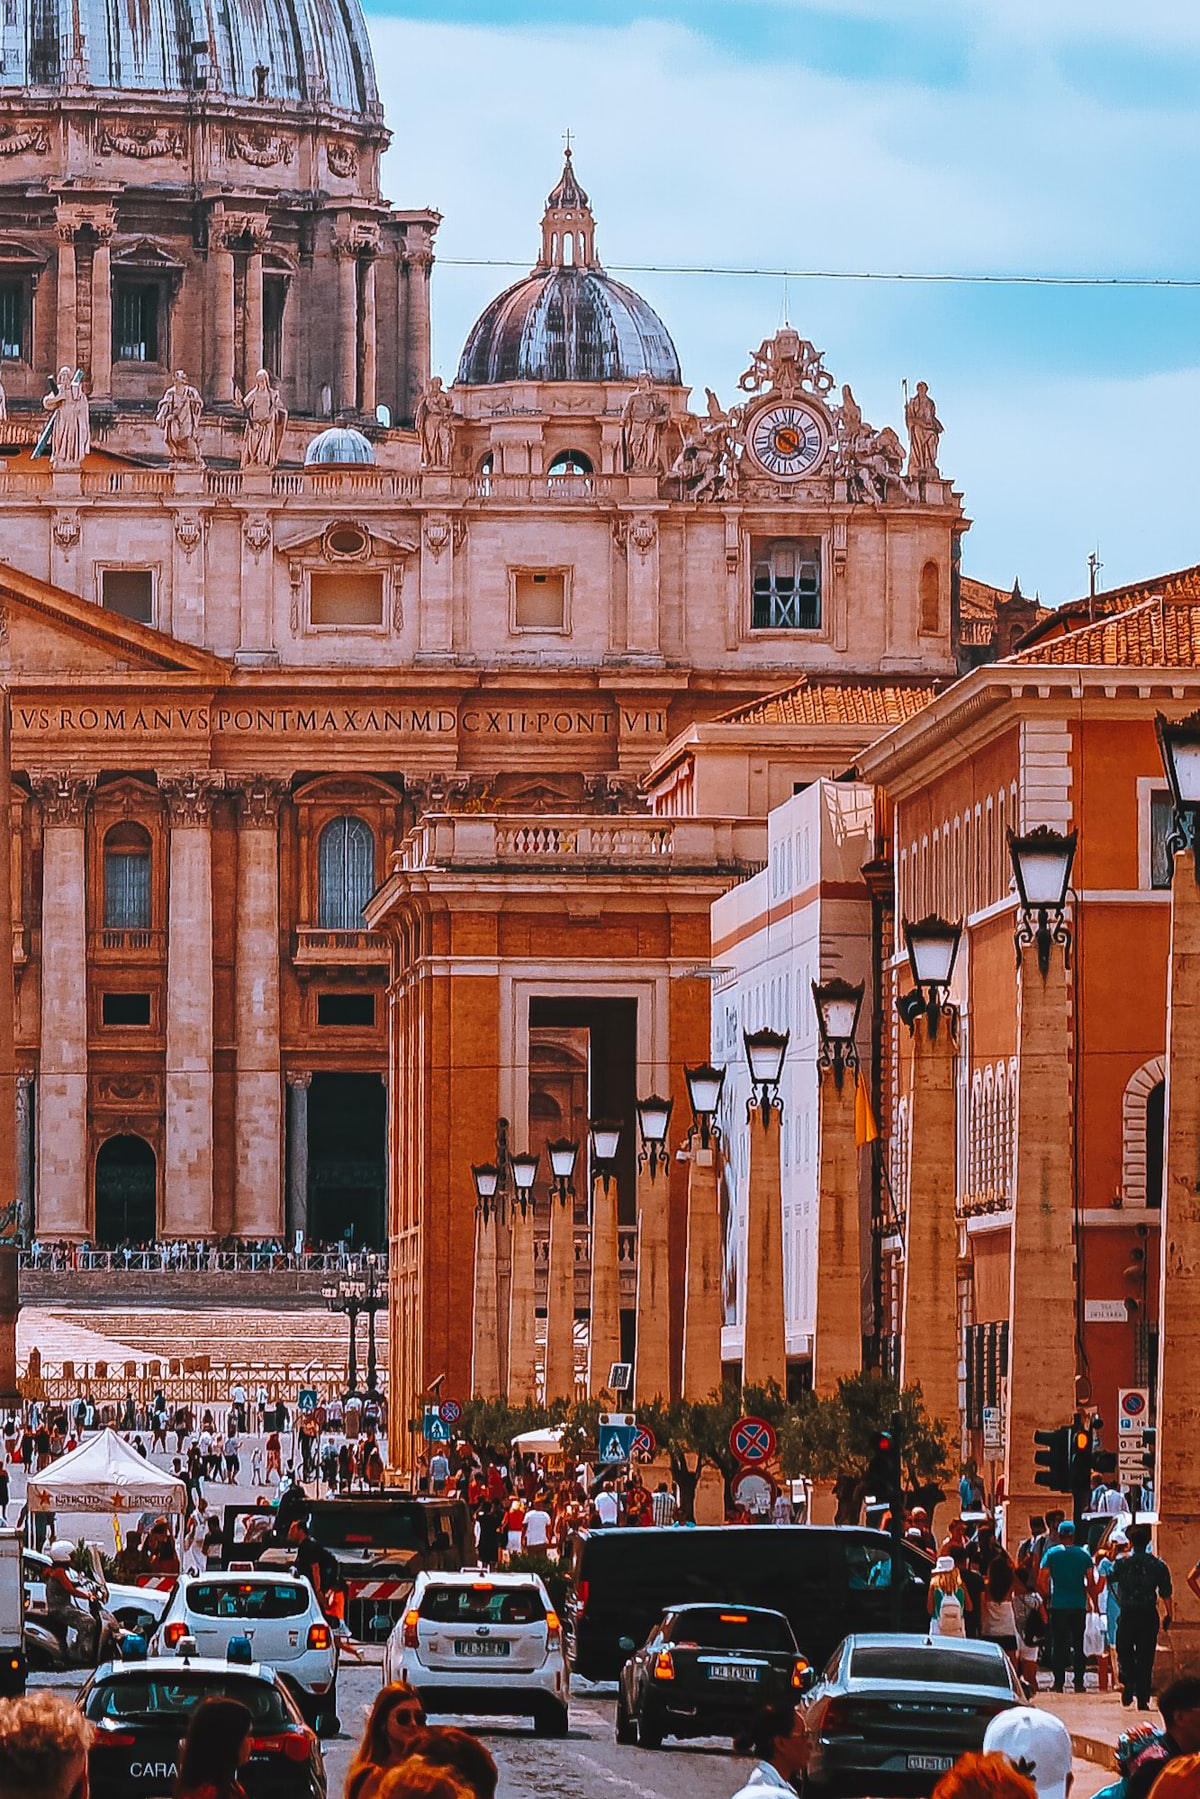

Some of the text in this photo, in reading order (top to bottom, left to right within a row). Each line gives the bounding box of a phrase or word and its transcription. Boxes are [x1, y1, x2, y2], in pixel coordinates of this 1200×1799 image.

[60, 709, 208, 730] ROMANVS
[218, 709, 292, 730] PONT
[296, 710, 358, 731] MAX
[362, 710, 403, 731] AN
[537, 711, 613, 732] PONT
[625, 711, 663, 732] VII
